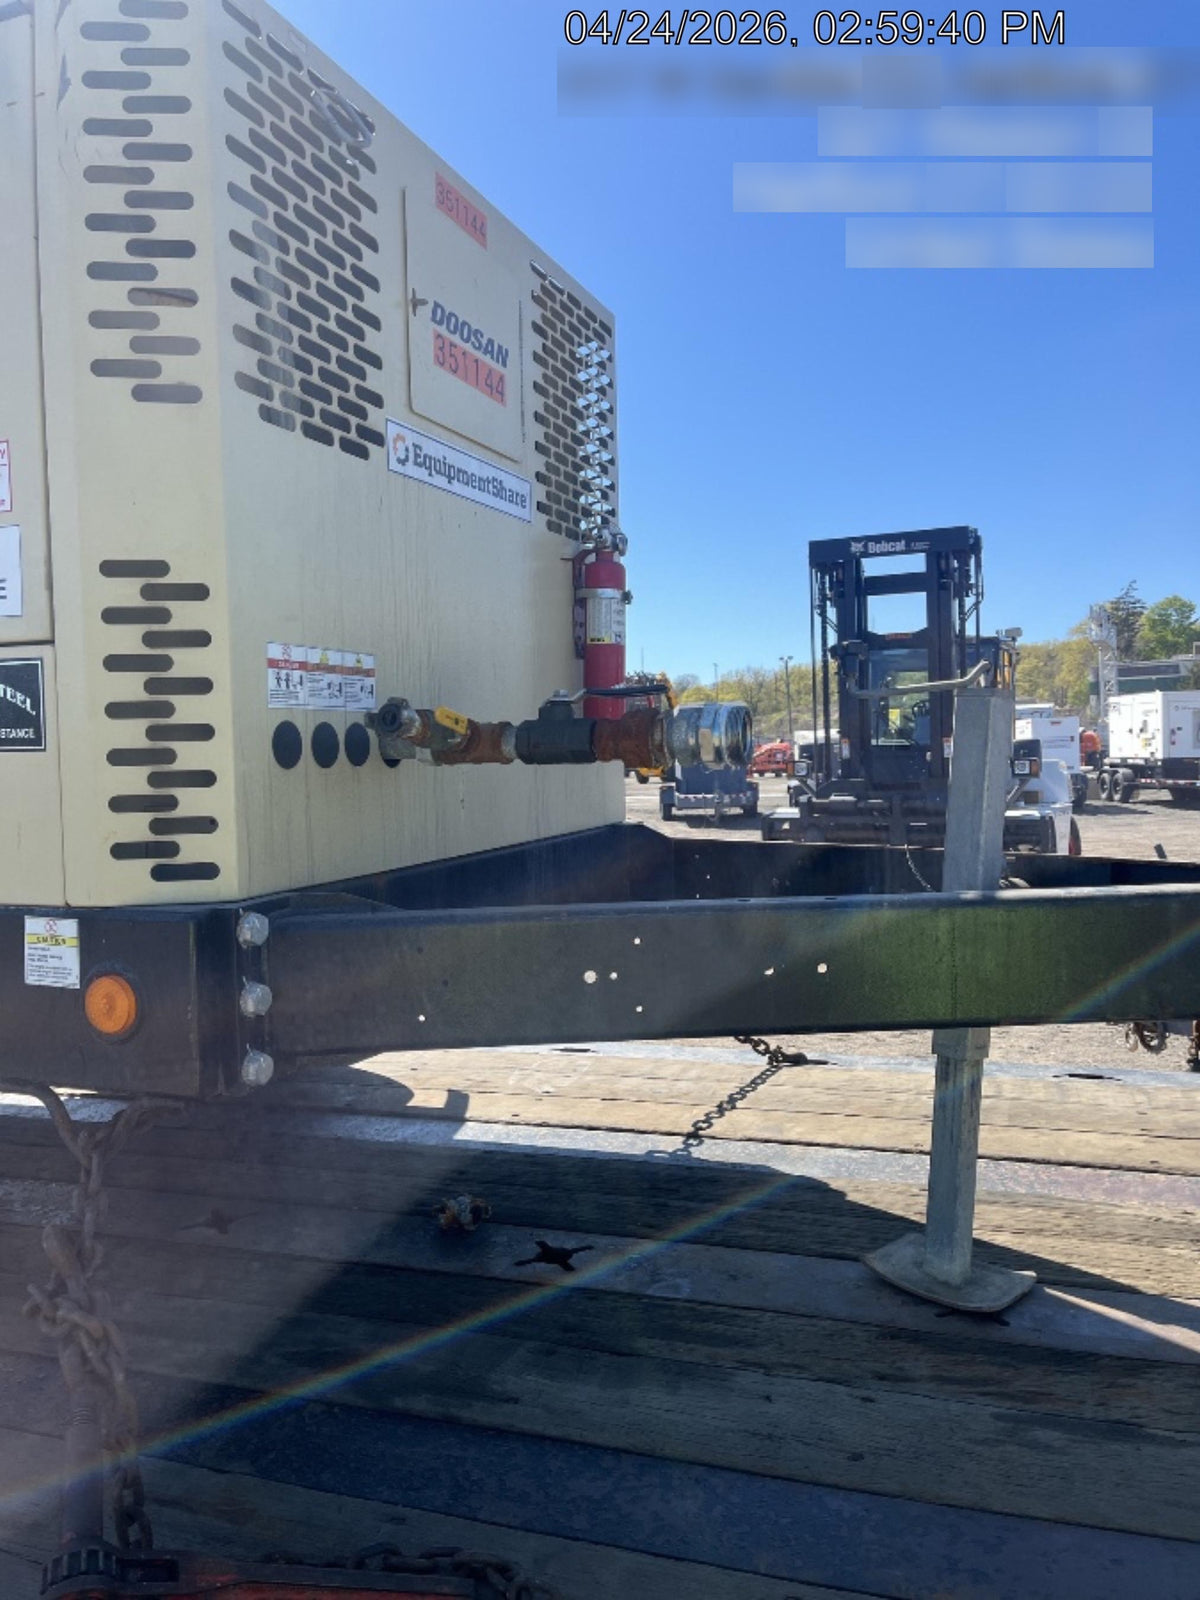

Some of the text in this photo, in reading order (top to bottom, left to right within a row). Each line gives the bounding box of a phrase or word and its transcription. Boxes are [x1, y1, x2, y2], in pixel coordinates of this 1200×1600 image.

[437, 181, 487, 238] 351144
[431, 300, 510, 368] DOOSAN
[434, 334, 507, 401] 351144
[412, 442, 527, 509] EquipmentShare
[867, 540, 906, 554] Bobcat
